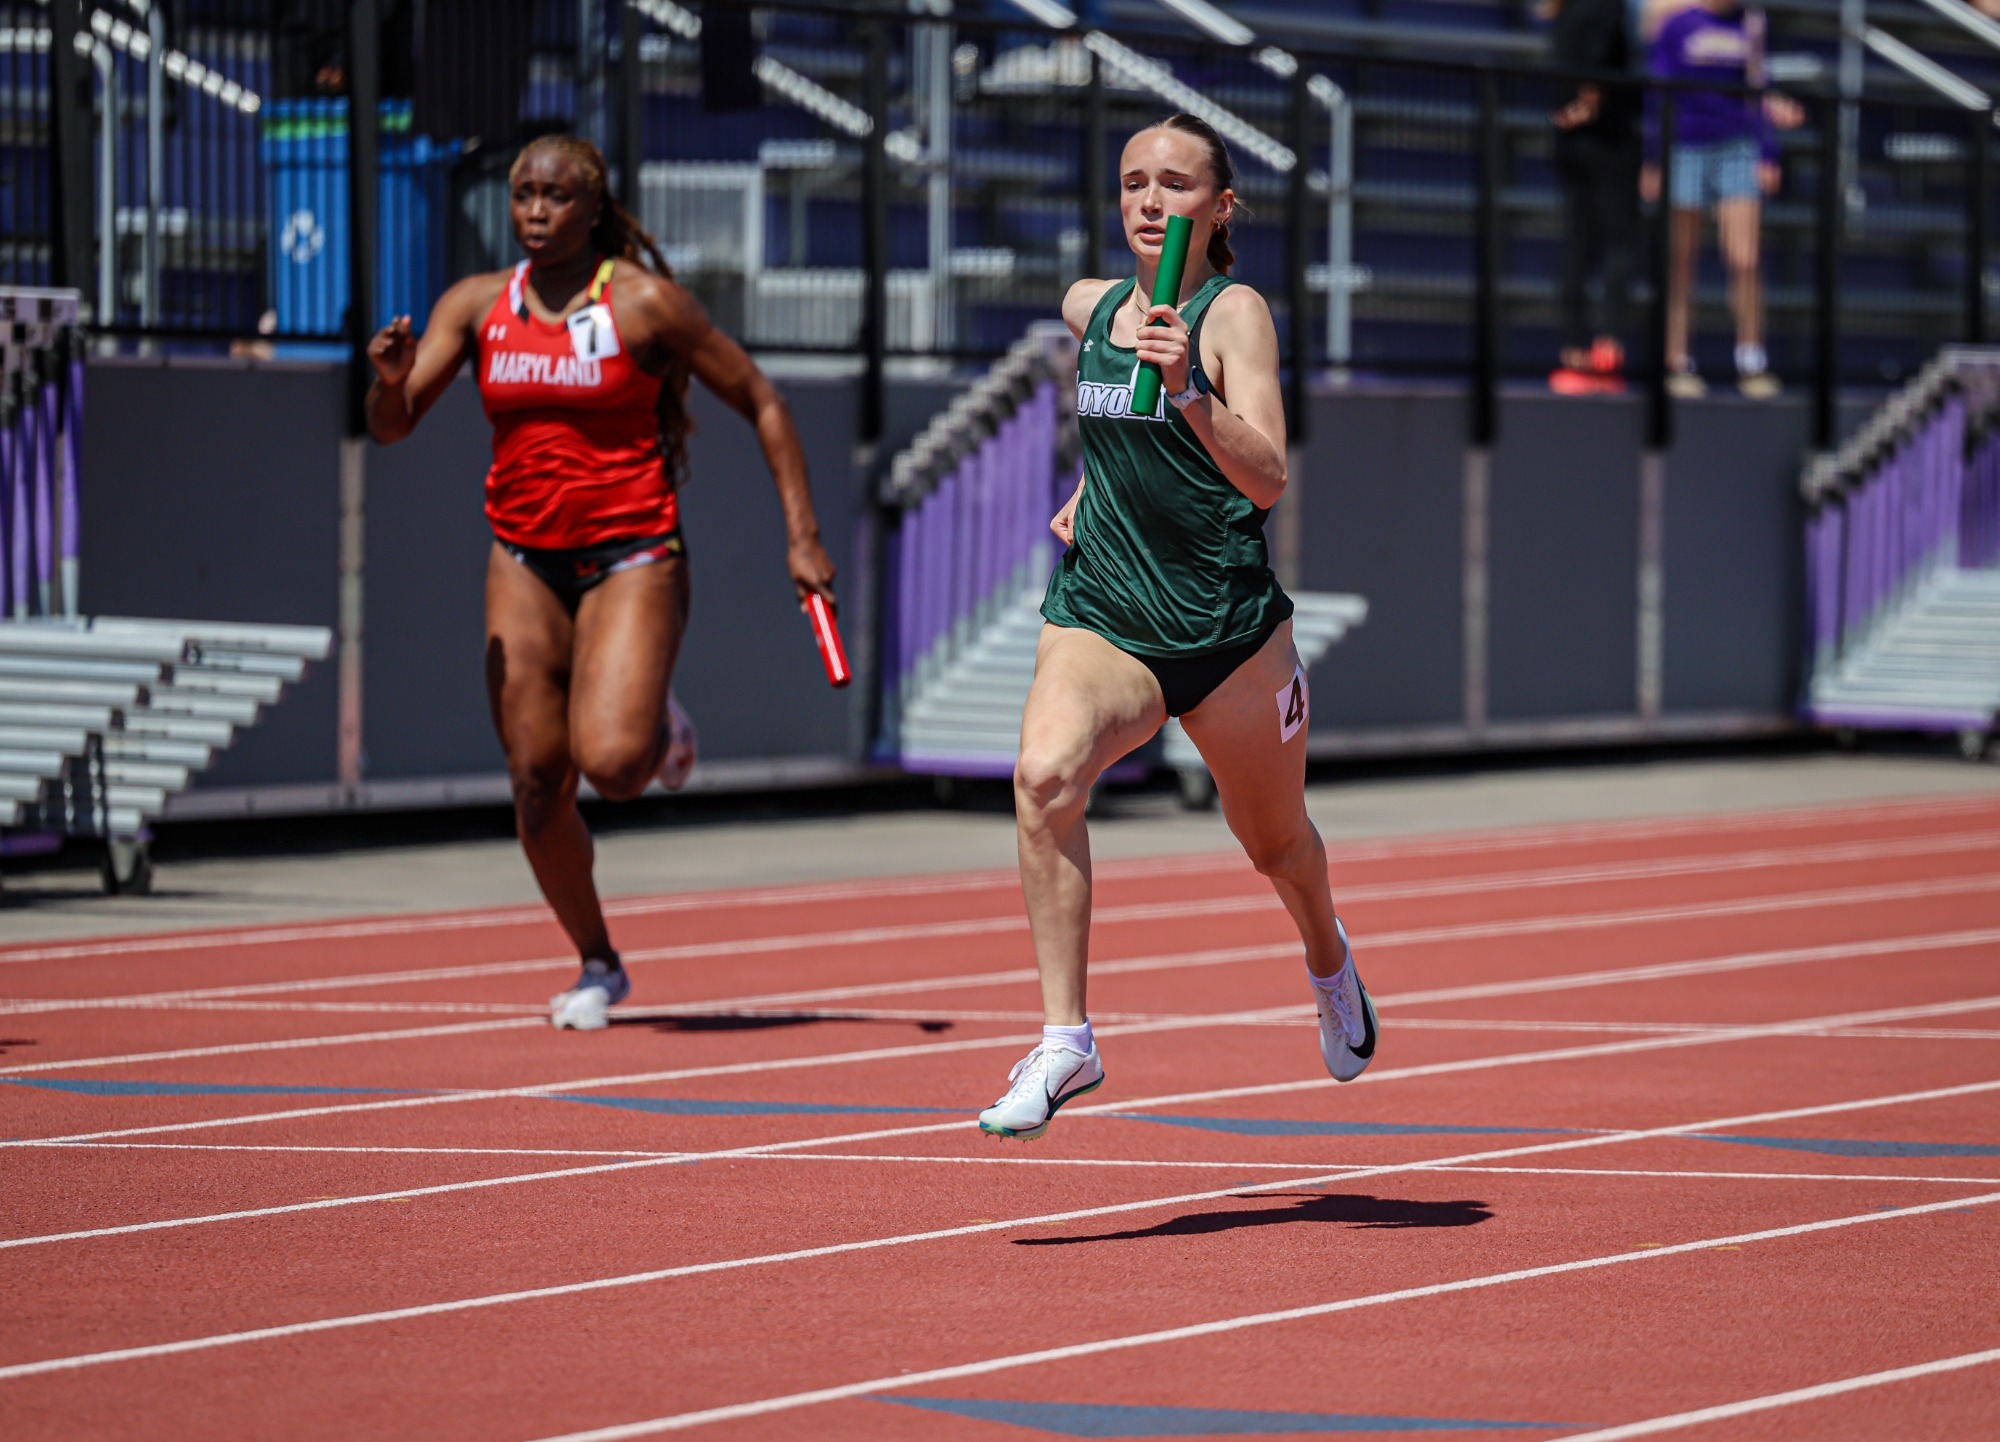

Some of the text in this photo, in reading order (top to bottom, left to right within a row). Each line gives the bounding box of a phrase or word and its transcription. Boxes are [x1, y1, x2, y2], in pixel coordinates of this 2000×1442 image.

[574, 313, 599, 354] 7
[488, 351, 602, 387] MARYLAND
[1284, 674, 1305, 729] 4
